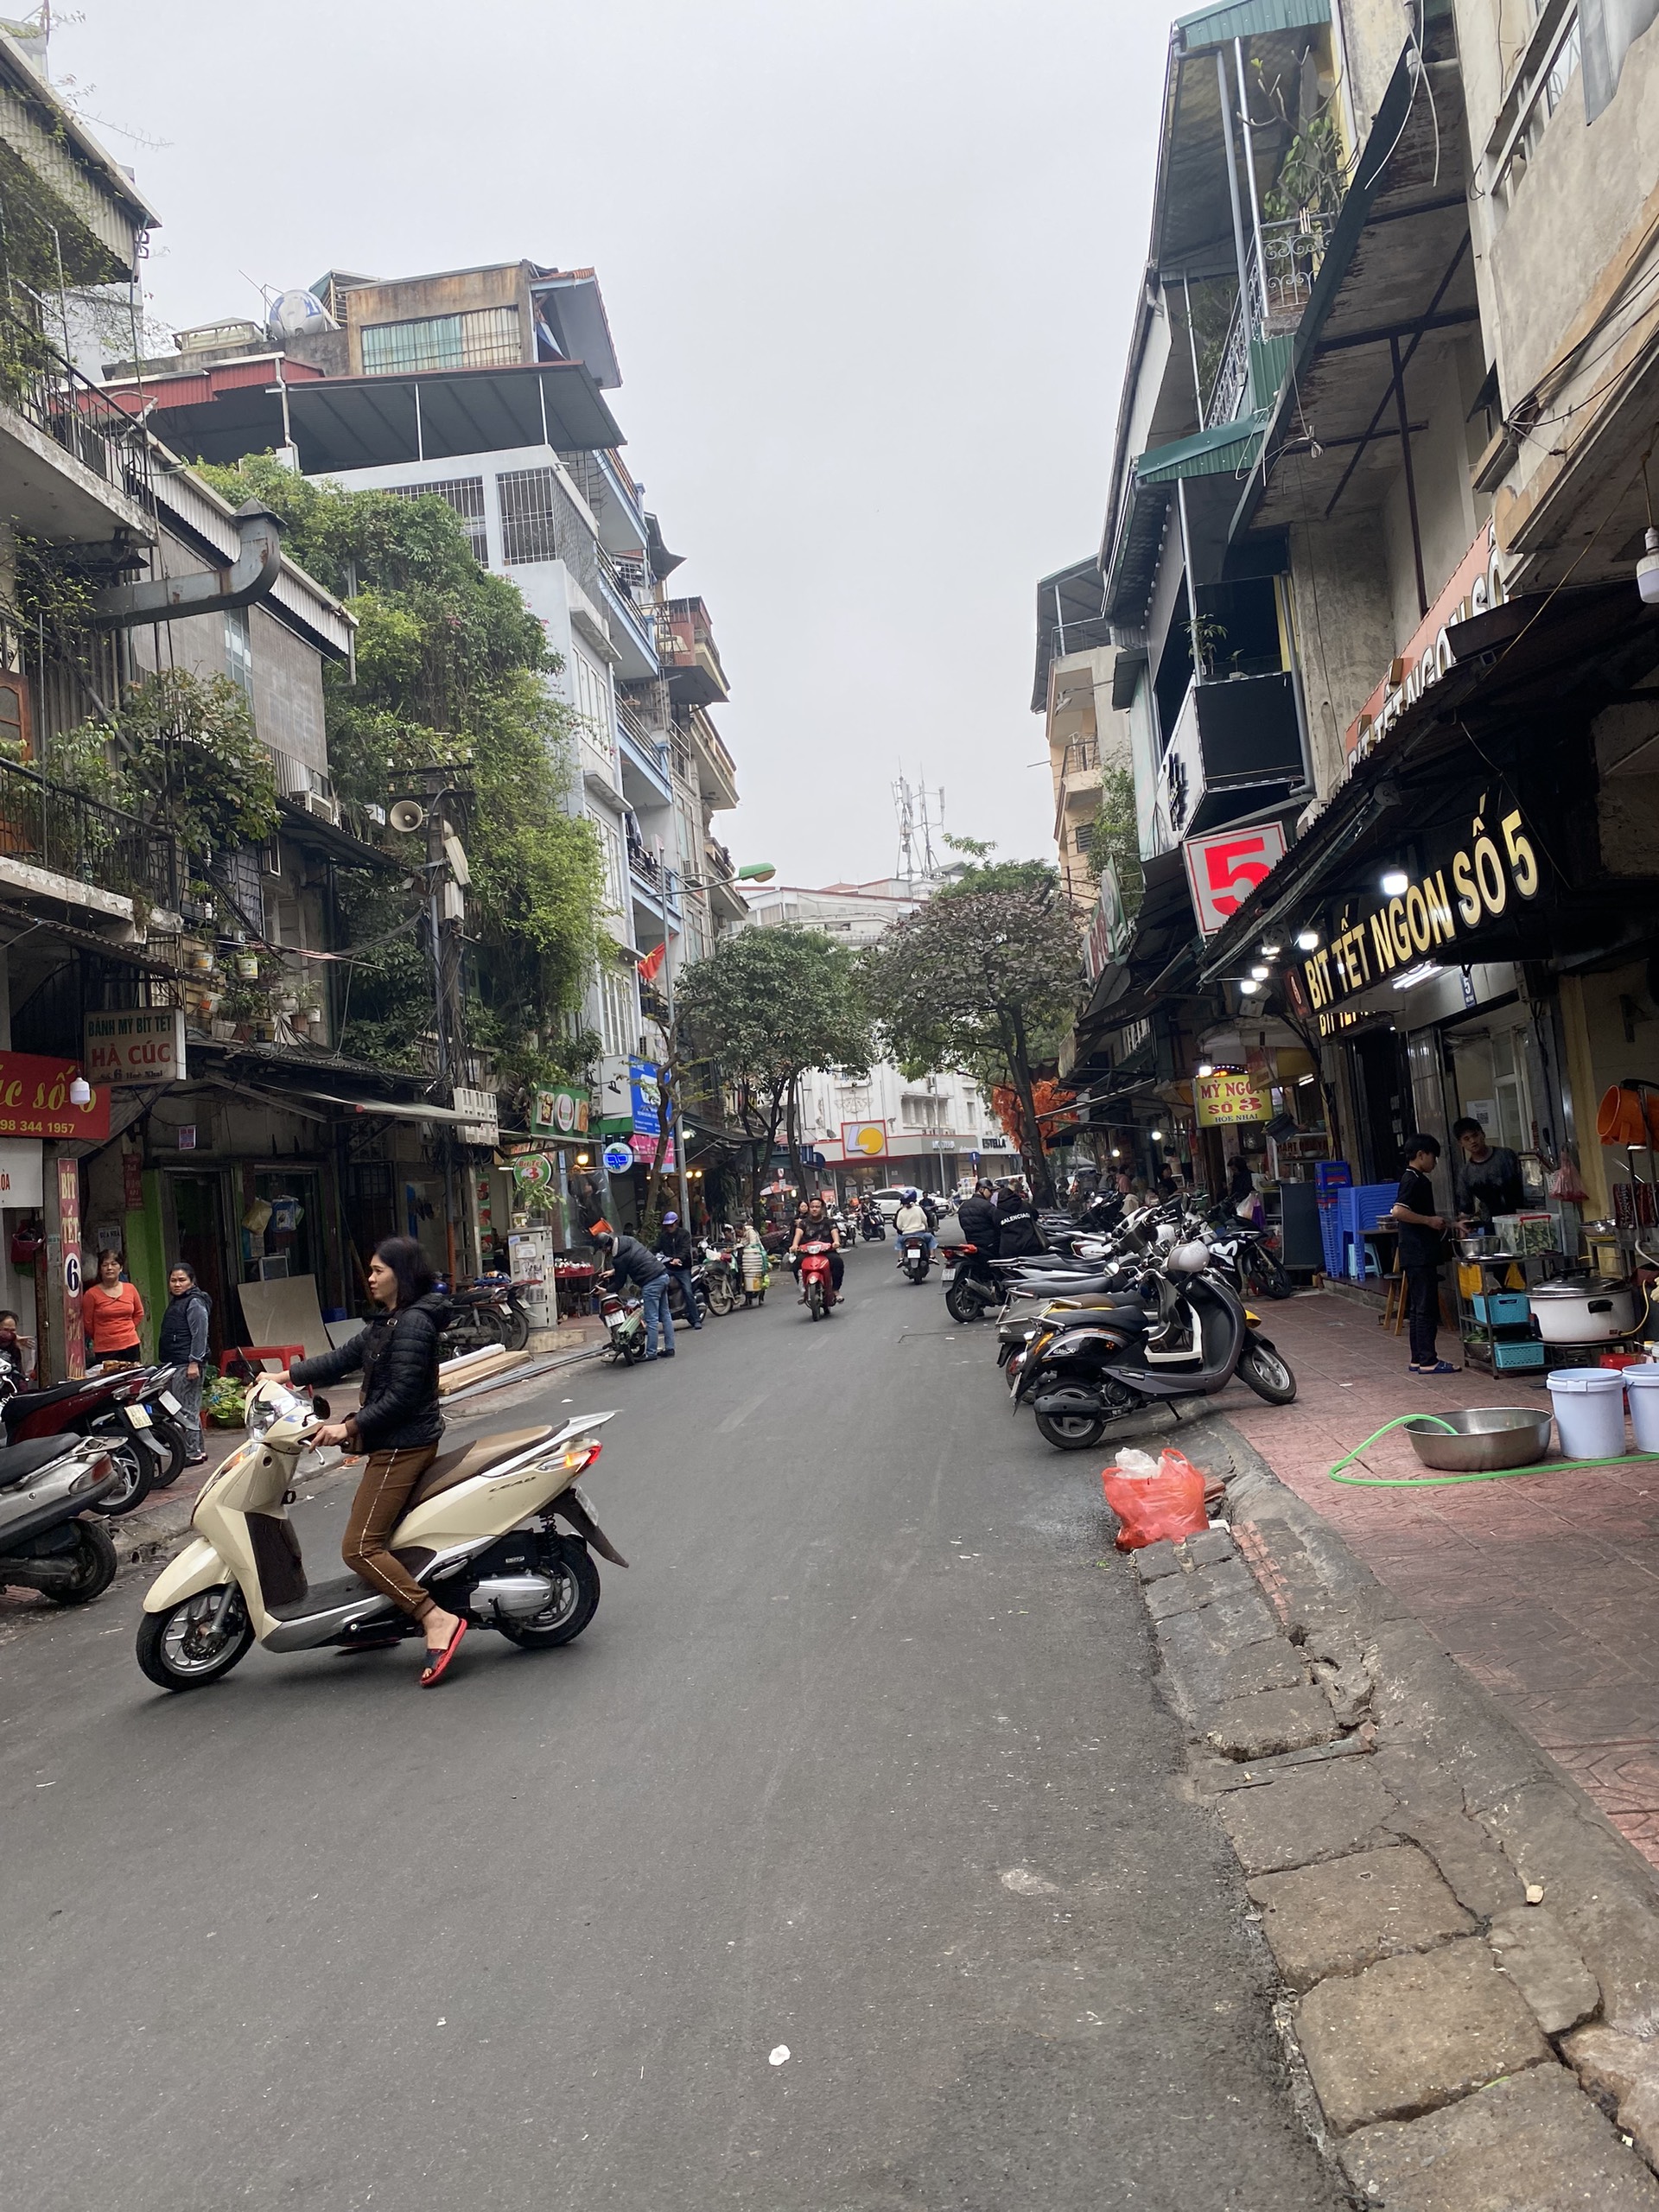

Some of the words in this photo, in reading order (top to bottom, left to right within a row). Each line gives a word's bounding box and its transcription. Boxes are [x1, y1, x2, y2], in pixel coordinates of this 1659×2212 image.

[1205, 836, 1270, 916] 5
[1331, 904, 1370, 994] TẾT
[1370, 869, 1456, 975] NGON
[1452, 792, 1506, 926] SỐ
[1501, 809, 1538, 897] 5
[1463, 977, 1471, 995] 5
[88, 1017, 116, 1037] BÁNH
[118, 1014, 133, 1034] MỲ
[136, 1014, 153, 1033] BÍT
[156, 1011, 172, 1032] TẾT
[92, 1043, 122, 1067] HÀ
[128, 1040, 170, 1065] CÚC
[113, 1068, 123, 1079] 6
[32, 1065, 76, 1111] số
[1200, 1080, 1221, 1099] MỲ
[1226, 1079, 1266, 1096] NGO
[1208, 1099, 1233, 1115] SỐ
[1239, 1097, 1262, 1112] 3
[1236, 1113, 1259, 1122] NHAI
[20, 1121, 42, 1132] 344
[48, 1122, 75, 1134] 1957
[982, 1138, 1007, 1149] ESTELLA
[60, 1165, 76, 1199] BÍT
[526, 1166, 539, 1179] 3
[61, 1205, 79, 1244] TẾT
[67, 1258, 79, 1292] 6
